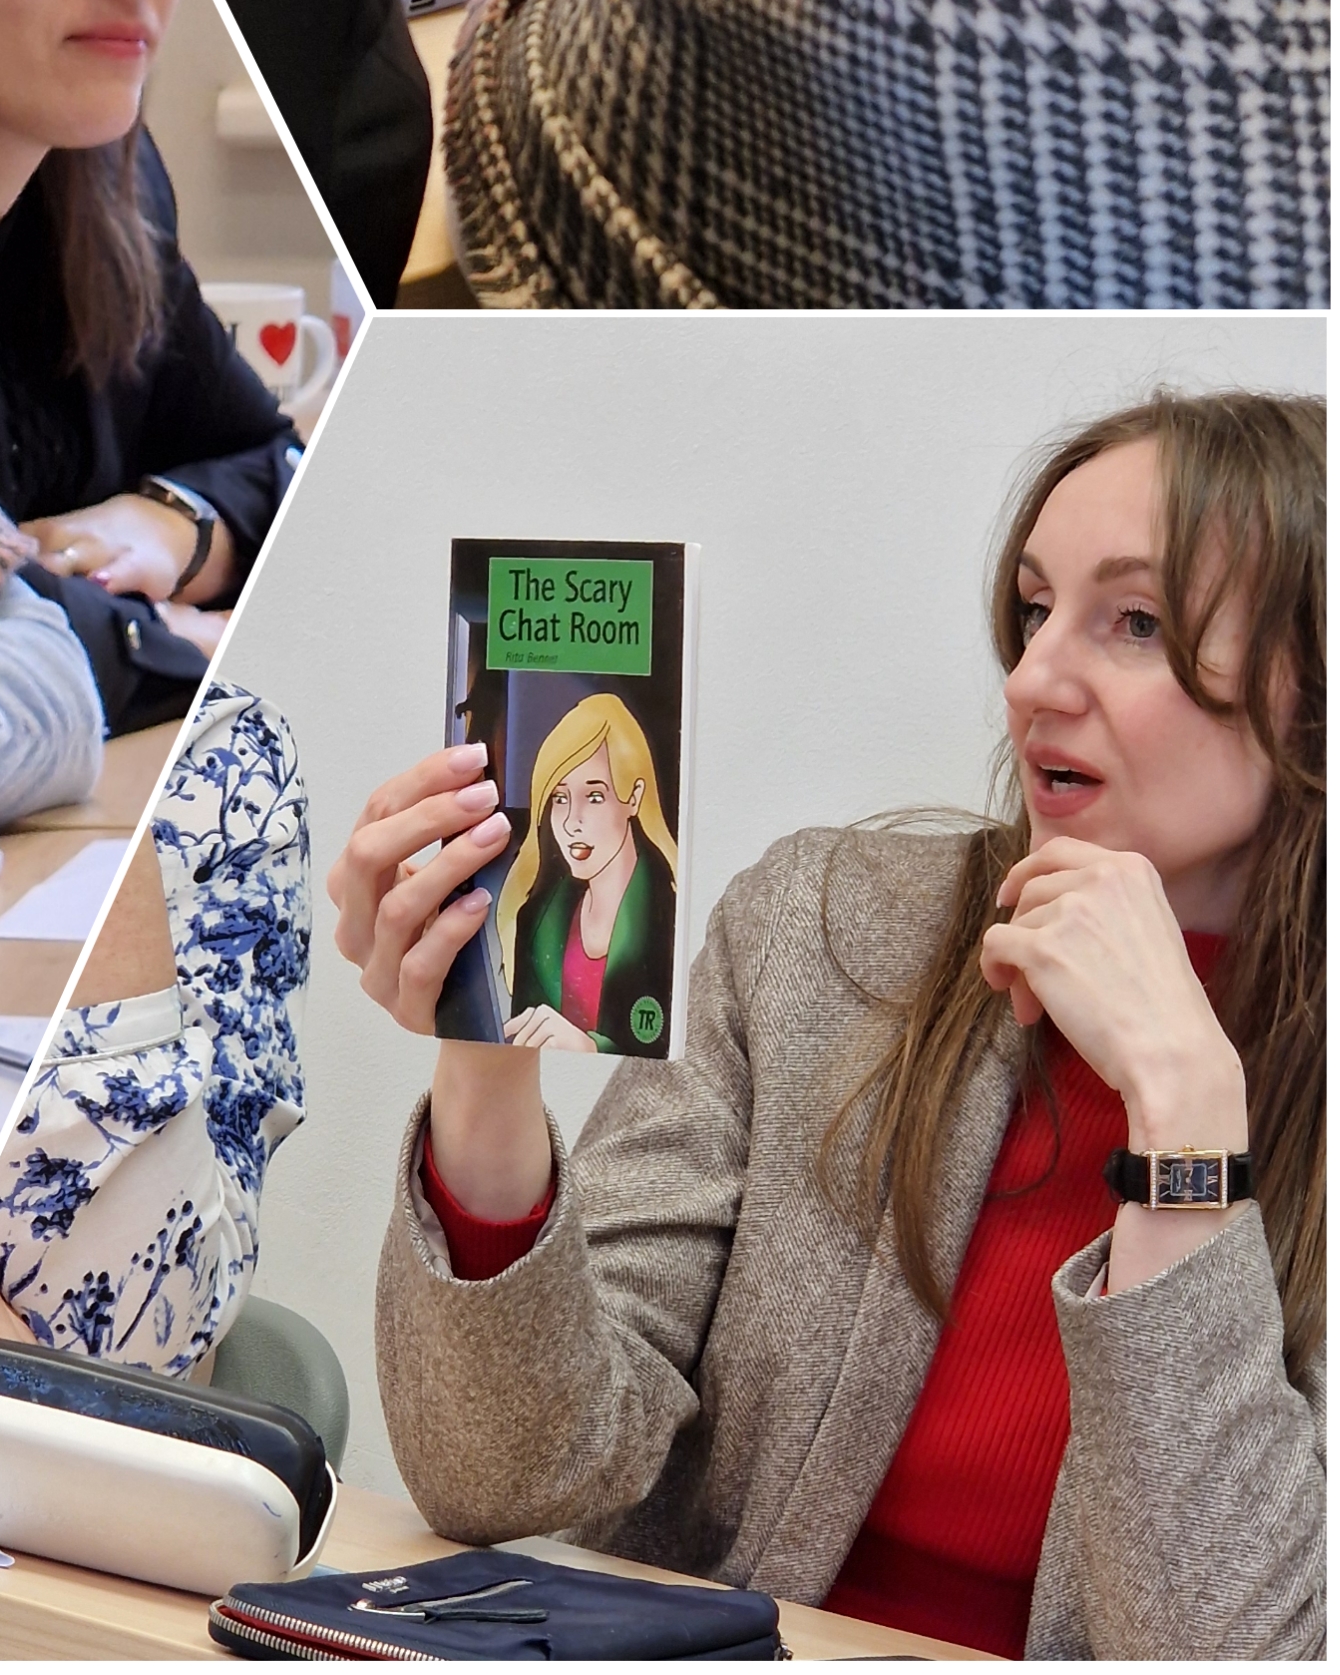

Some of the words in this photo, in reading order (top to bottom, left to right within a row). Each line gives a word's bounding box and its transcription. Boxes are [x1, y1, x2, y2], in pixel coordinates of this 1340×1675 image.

[508, 567, 556, 602] The
[564, 569, 633, 613] Scary
[498, 607, 561, 642] Chat
[570, 611, 640, 645] Room
[505, 651, 524, 663] Rita
[638, 1009, 656, 1031] TR
